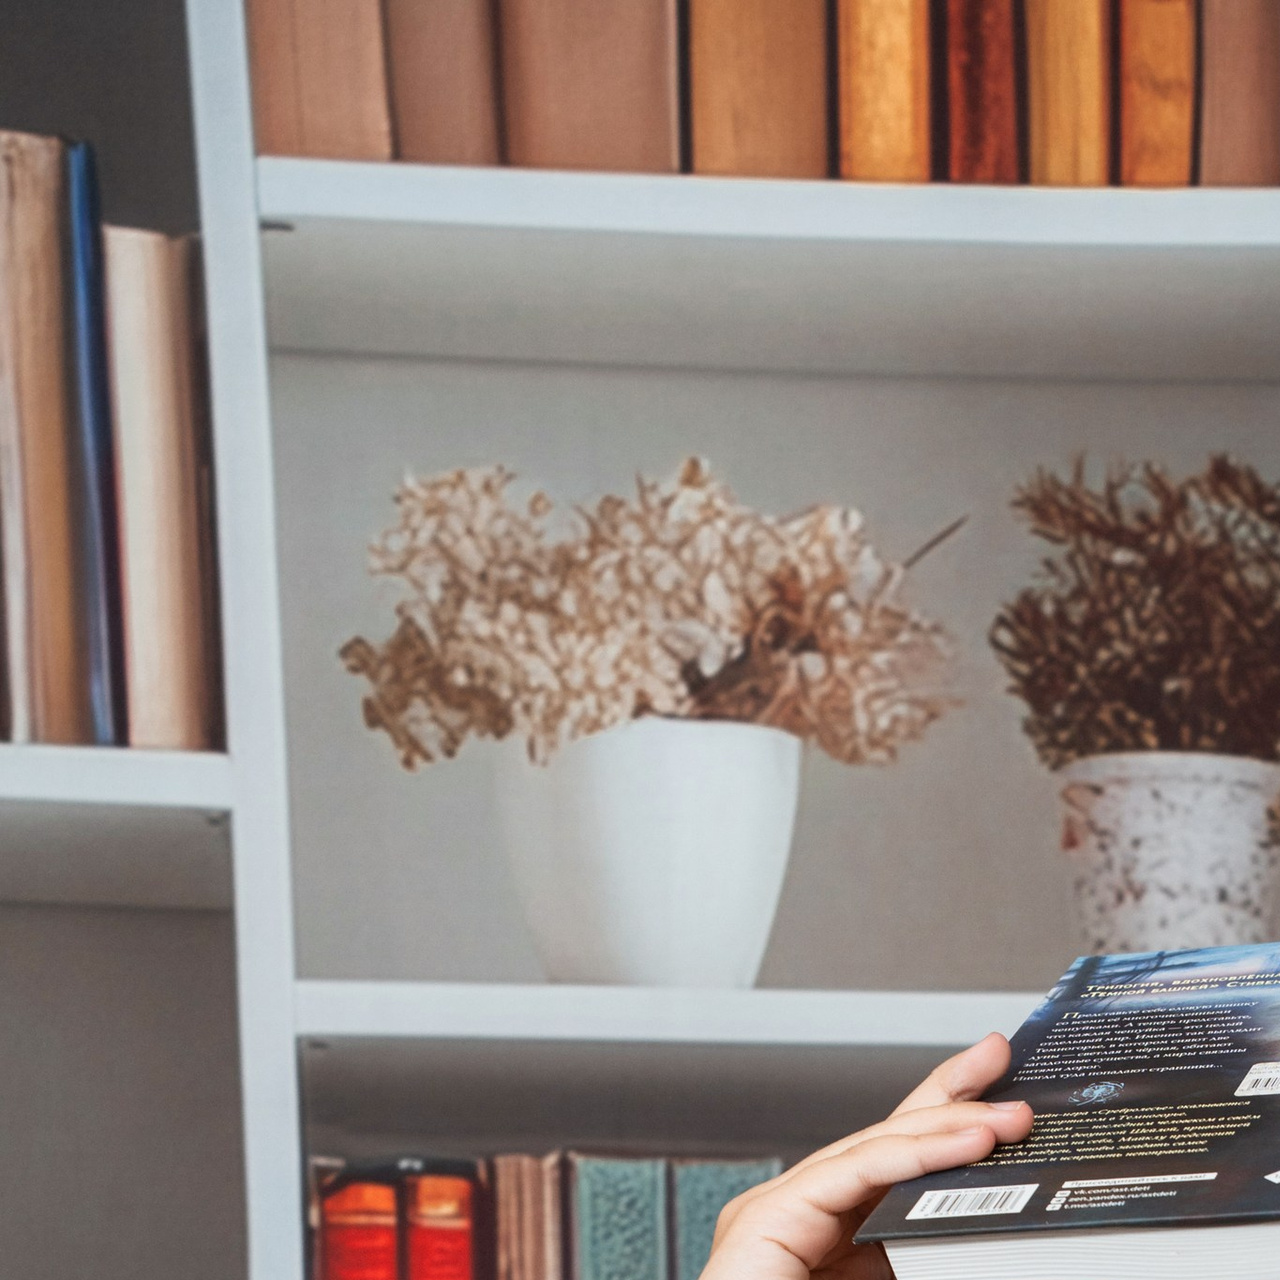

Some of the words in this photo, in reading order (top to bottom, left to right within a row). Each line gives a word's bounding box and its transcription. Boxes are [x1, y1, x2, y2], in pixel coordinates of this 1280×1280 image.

[1062, 1010, 1140, 1019] Представьте
[1123, 1009, 1232, 1021] многочисленными
[1051, 1024, 1119, 1032] чешуйками.
[1179, 1015, 1252, 1024] представьте,
[1040, 1038, 1103, 1046] отдельный
[1036, 1045, 1105, 1053] Темногорье,
[1025, 1059, 1091, 1067] загадочные
[1093, 1055, 1150, 1063] существа,
[1176, 1101, 1251, 1109] оказывается
[1046, 1117, 1107, 1125] порталом
[1119, 1112, 1187, 1120] Темногорье.
[1091, 1121, 1154, 1129] последним
[1070, 1130, 1127, 1138] девушкой
[1183, 1122, 1251, 1132] привыкшей
[1169, 1131, 1235, 1140] предстоит
[1059, 1153, 1123, 1161] исправить
